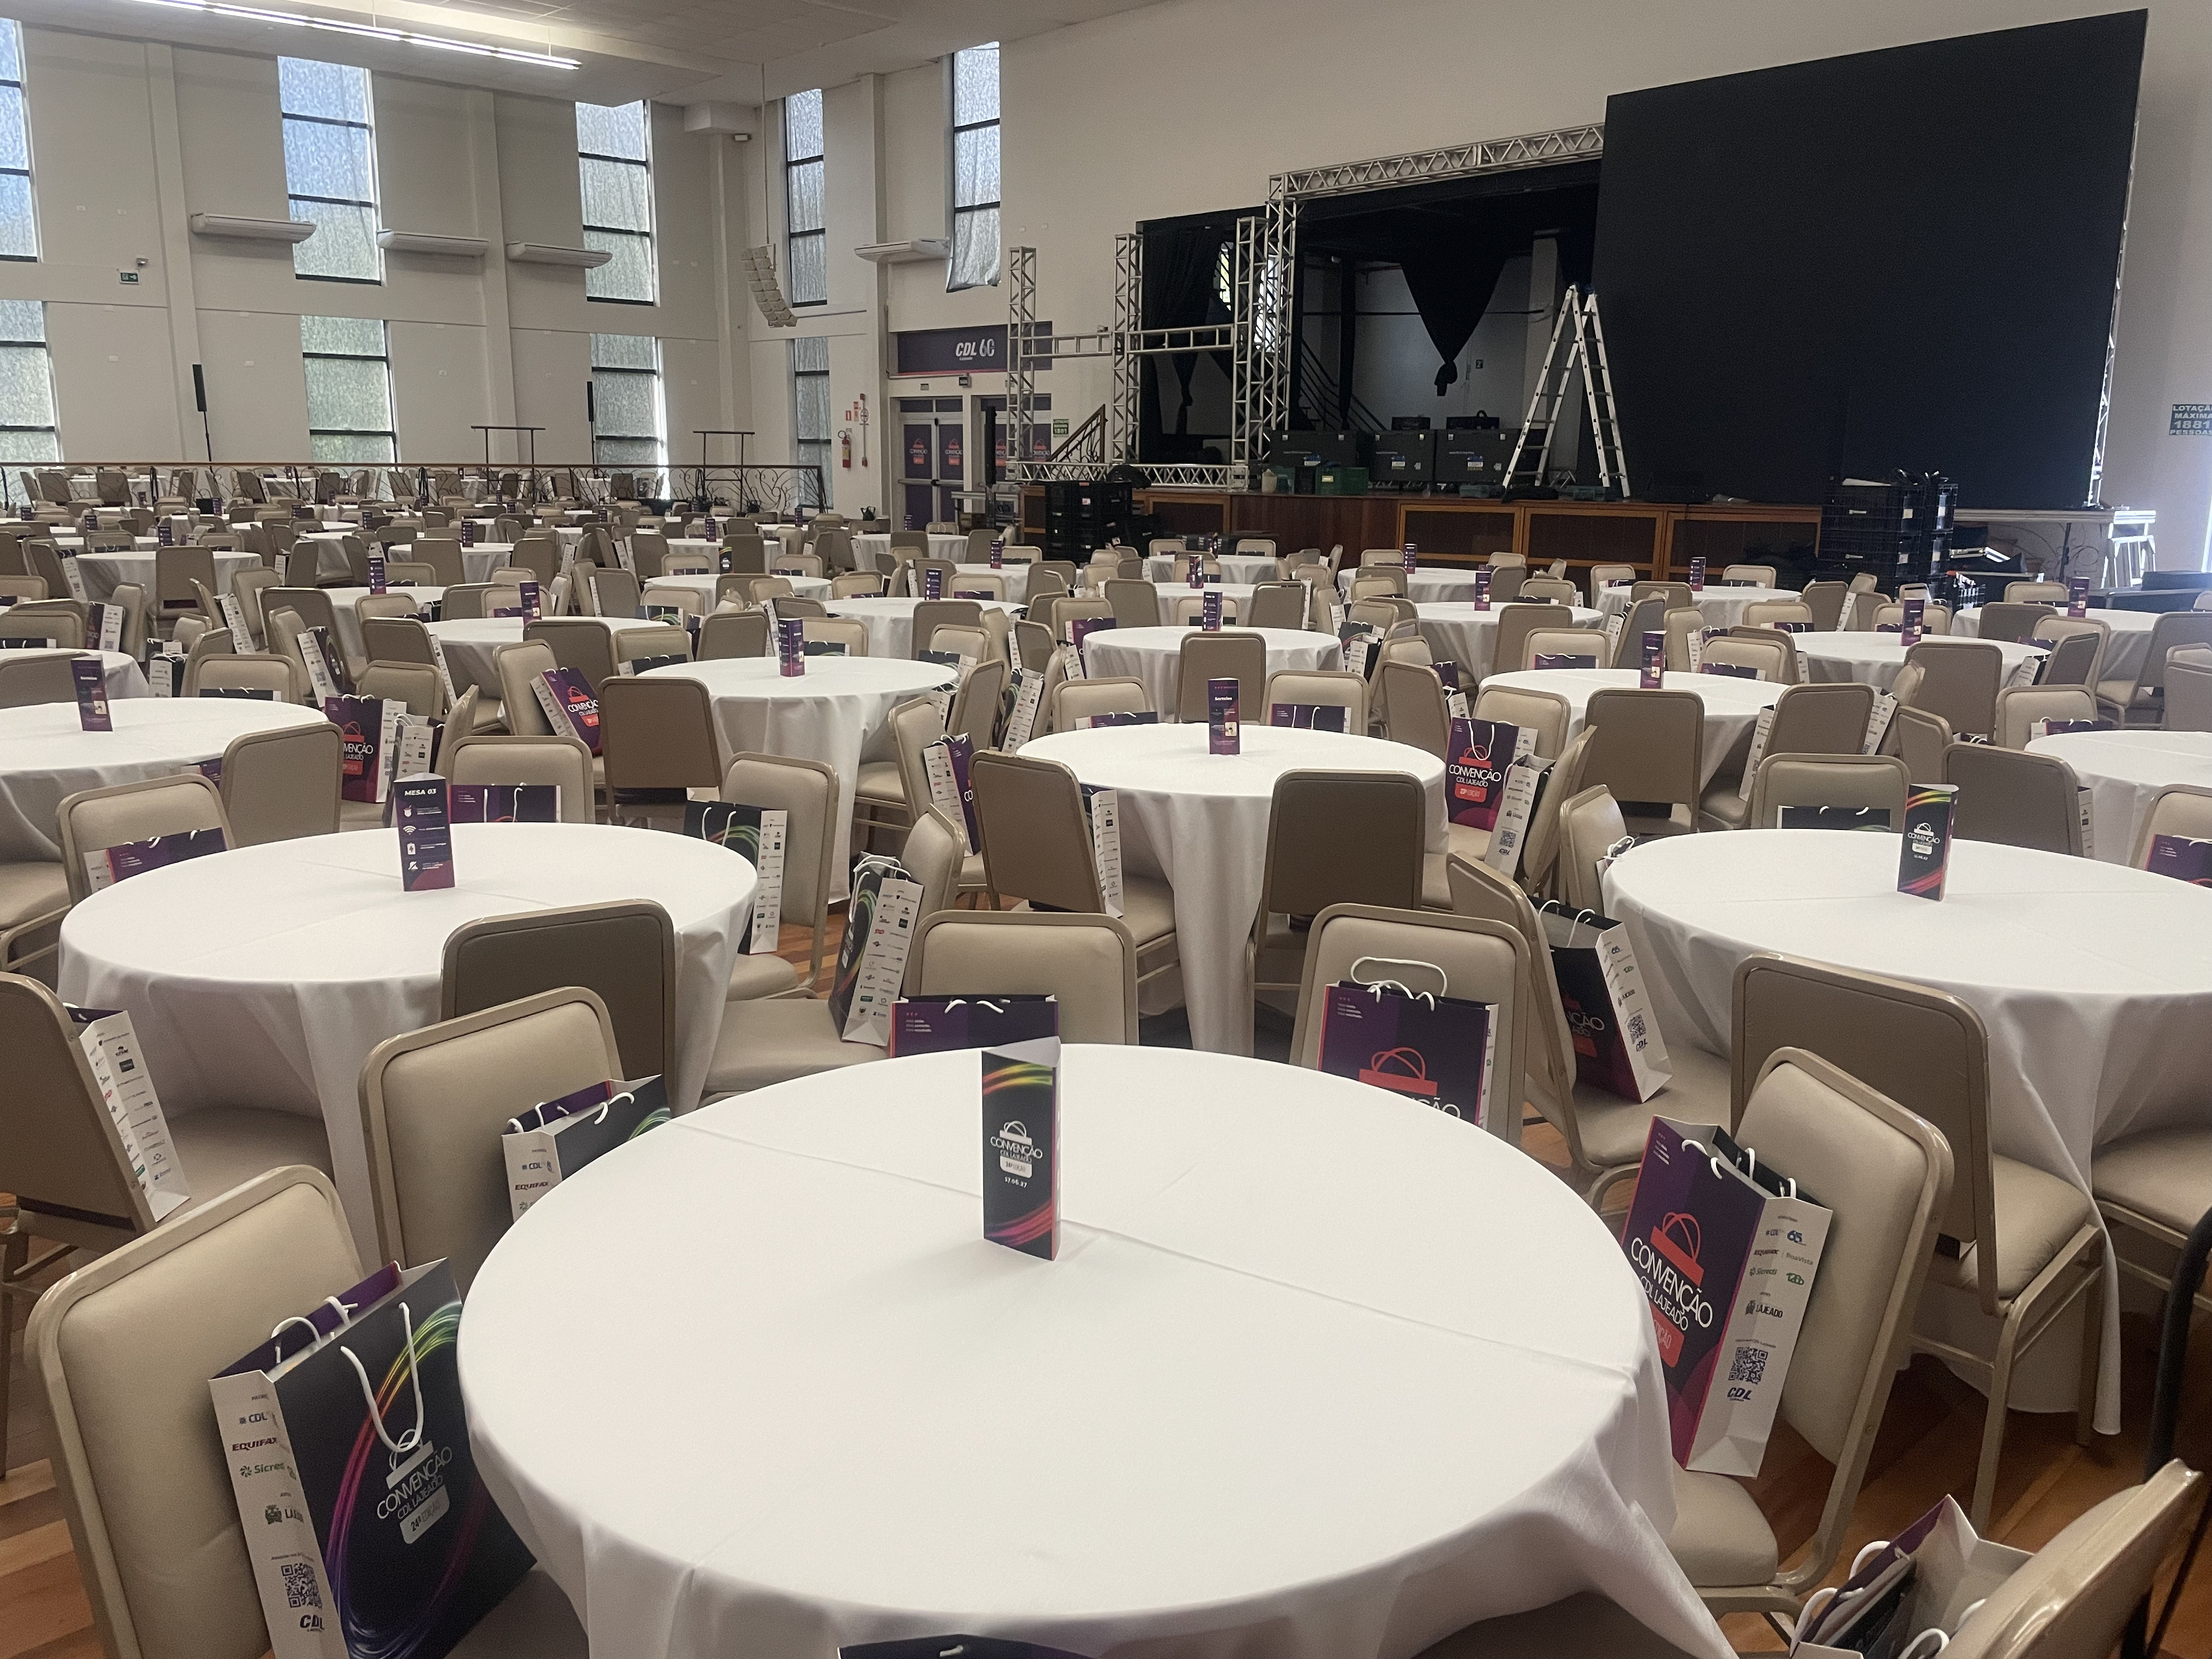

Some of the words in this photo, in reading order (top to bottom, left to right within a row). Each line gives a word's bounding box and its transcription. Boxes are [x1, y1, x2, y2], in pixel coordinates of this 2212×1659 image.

[956, 342, 977, 357] CDL
[2173, 404, 2212, 413] LOTAÇÃ
[2174, 420, 2210, 429] 1881
[1449, 764, 1502, 782] CONVENÇÃO
[990, 1136, 1043, 1159] CONVENÇÃO
[1631, 1237, 1713, 1328] CONVENÇÃO
[1653, 1288, 1689, 1331] LAJEADO
[1756, 1304, 1784, 1318] LAJEADO
[1728, 1387, 1753, 1401] CDL
[249, 1412, 267, 1423] CDL
[232, 1437, 277, 1452] EQUIFAX
[377, 1446, 453, 1519] CONVENÇÃO
[397, 1501, 411, 1519] CDL
[411, 1475, 443, 1511] LAJEADO
